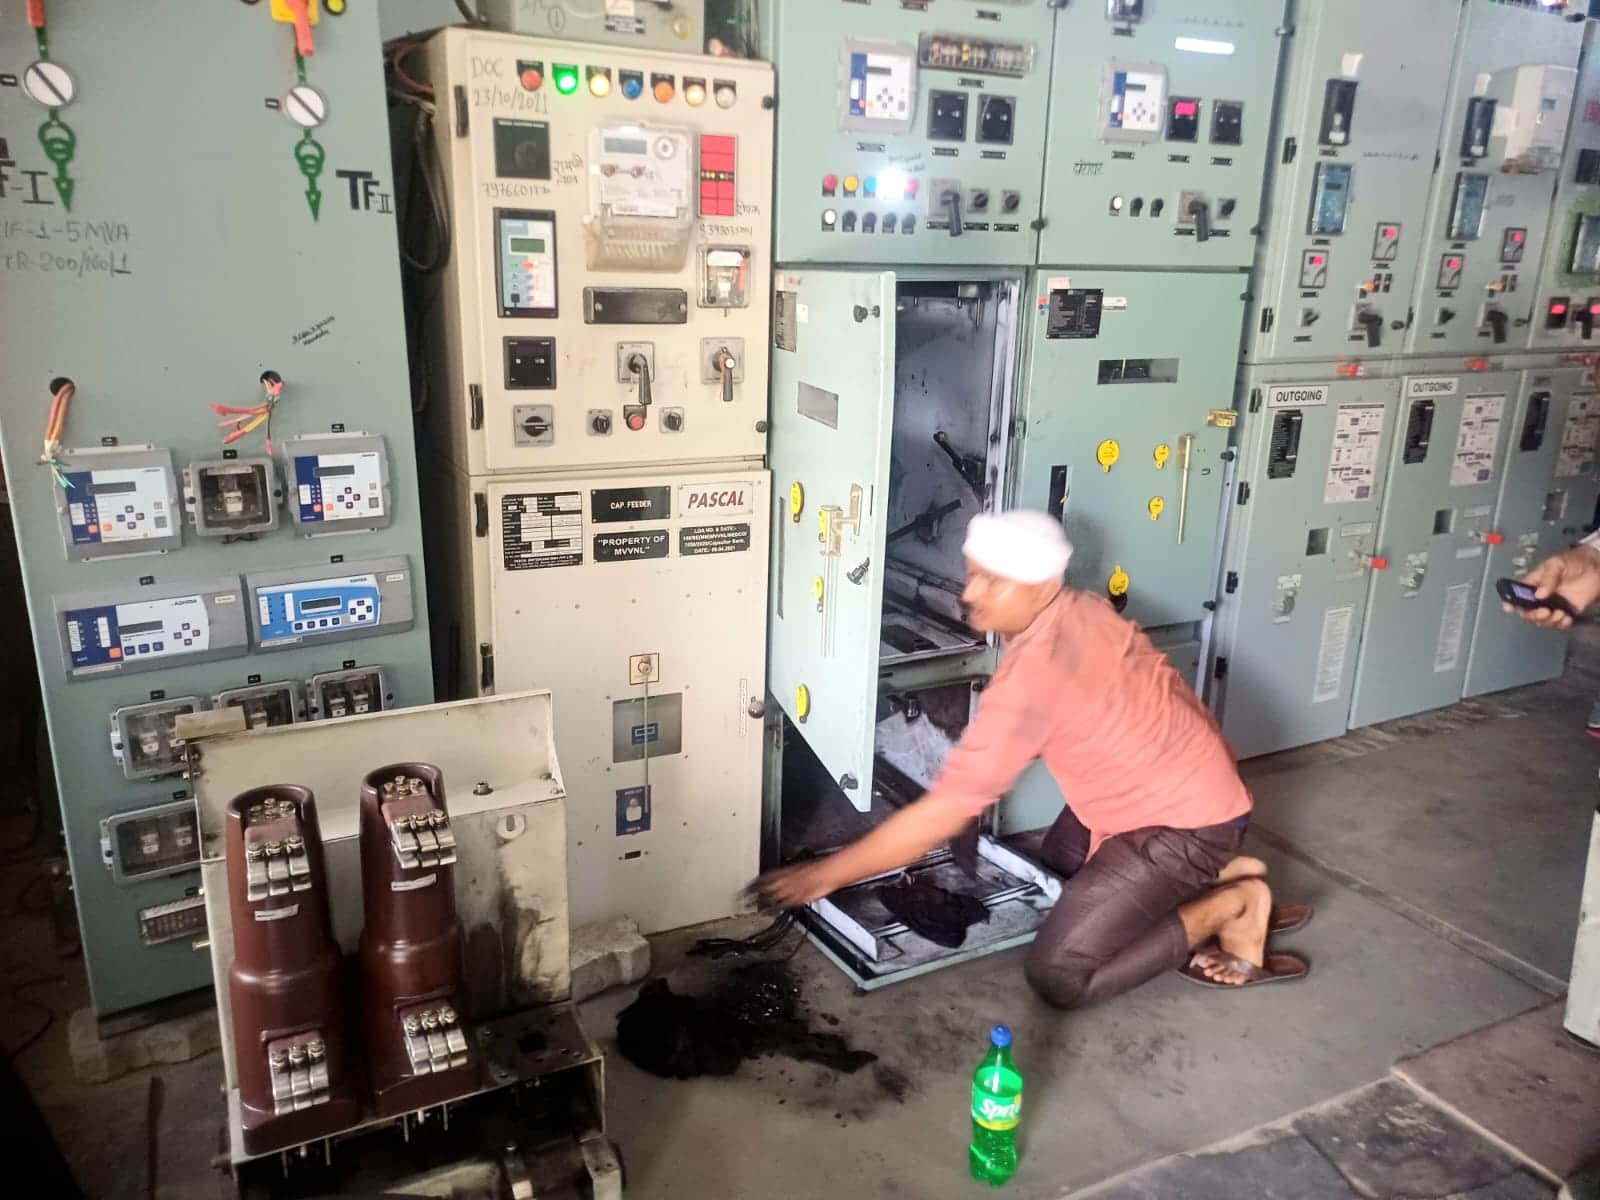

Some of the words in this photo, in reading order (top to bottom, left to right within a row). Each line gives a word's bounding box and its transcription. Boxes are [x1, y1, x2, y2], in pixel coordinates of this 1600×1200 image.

[1276, 390, 1323, 402] OUTGOING
[610, 501, 625, 510] CAP
[627, 499, 652, 509] FEEDER
[688, 490, 745, 509] PASCAL
[653, 535, 666, 543] OF
